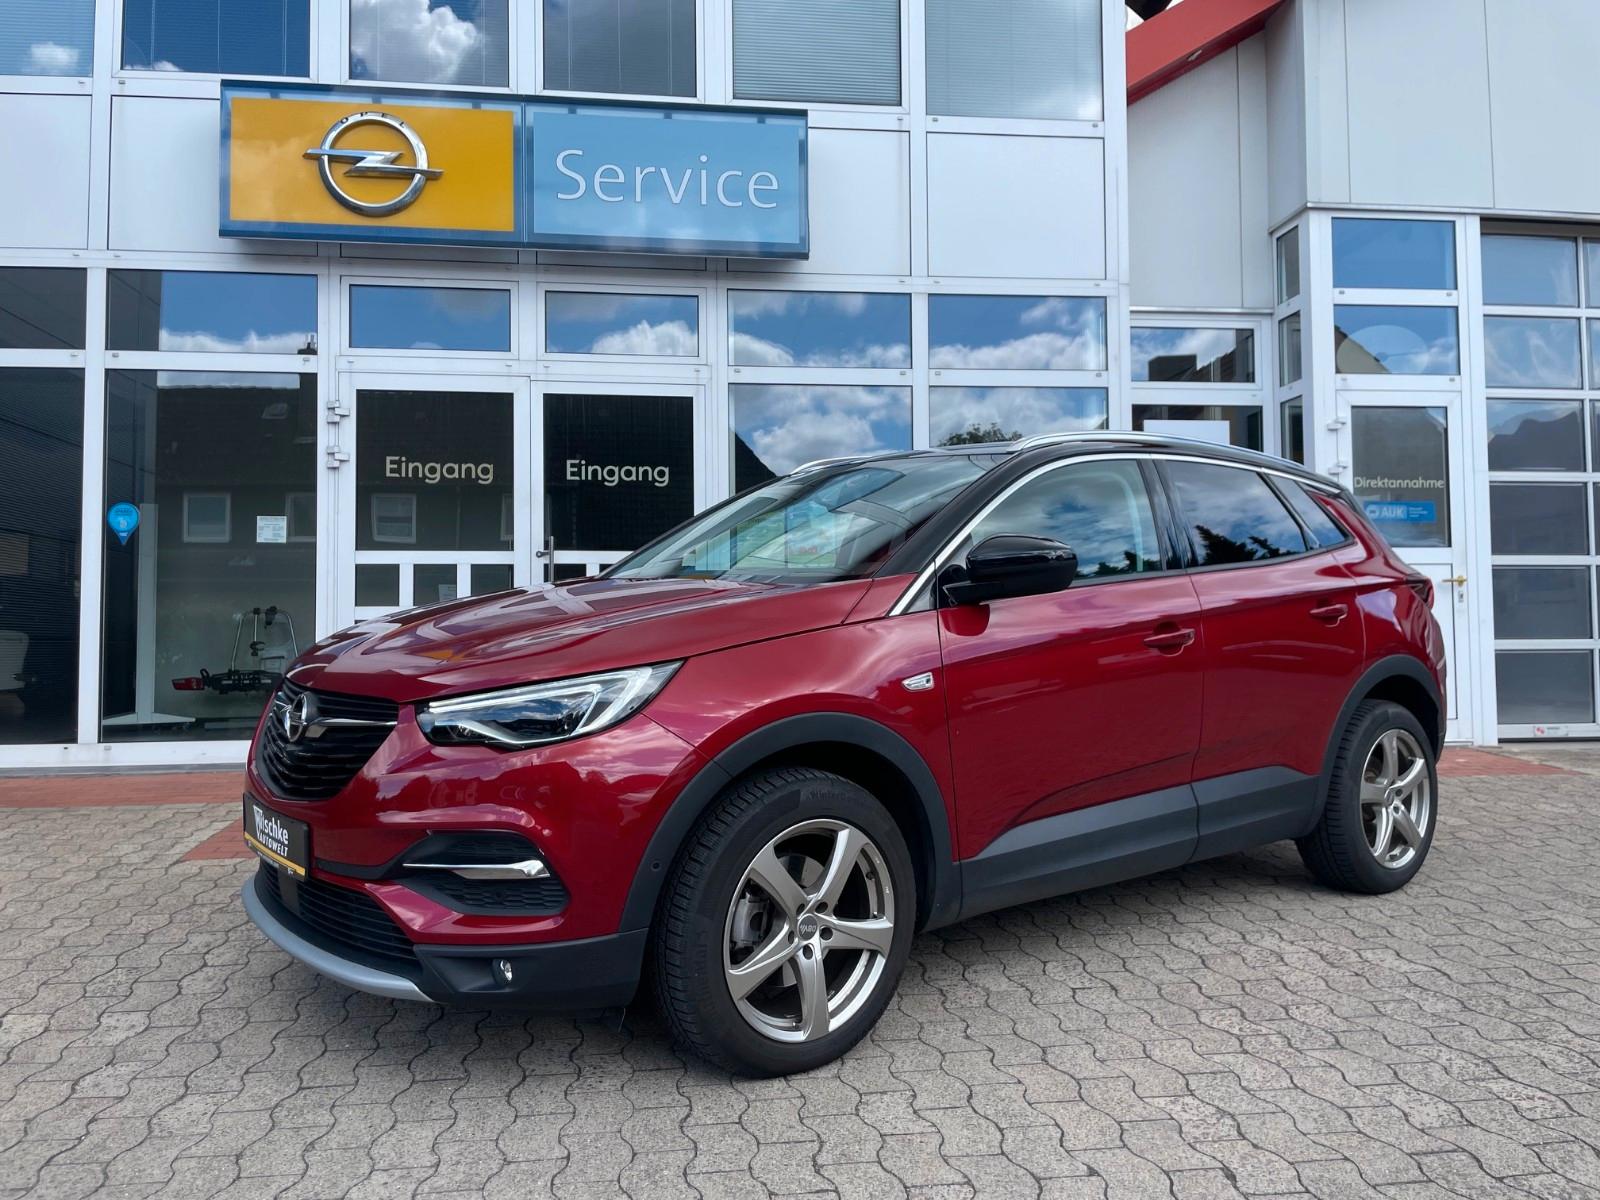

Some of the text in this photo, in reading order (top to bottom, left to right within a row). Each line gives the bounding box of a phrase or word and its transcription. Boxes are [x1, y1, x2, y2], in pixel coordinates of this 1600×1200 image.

[556, 149, 779, 208] Service
[385, 456, 494, 484] Eingang
[566, 459, 670, 487] Eingang
[1354, 475, 1445, 488] Direktannahme
[259, 833, 289, 857] AUTOWELT
